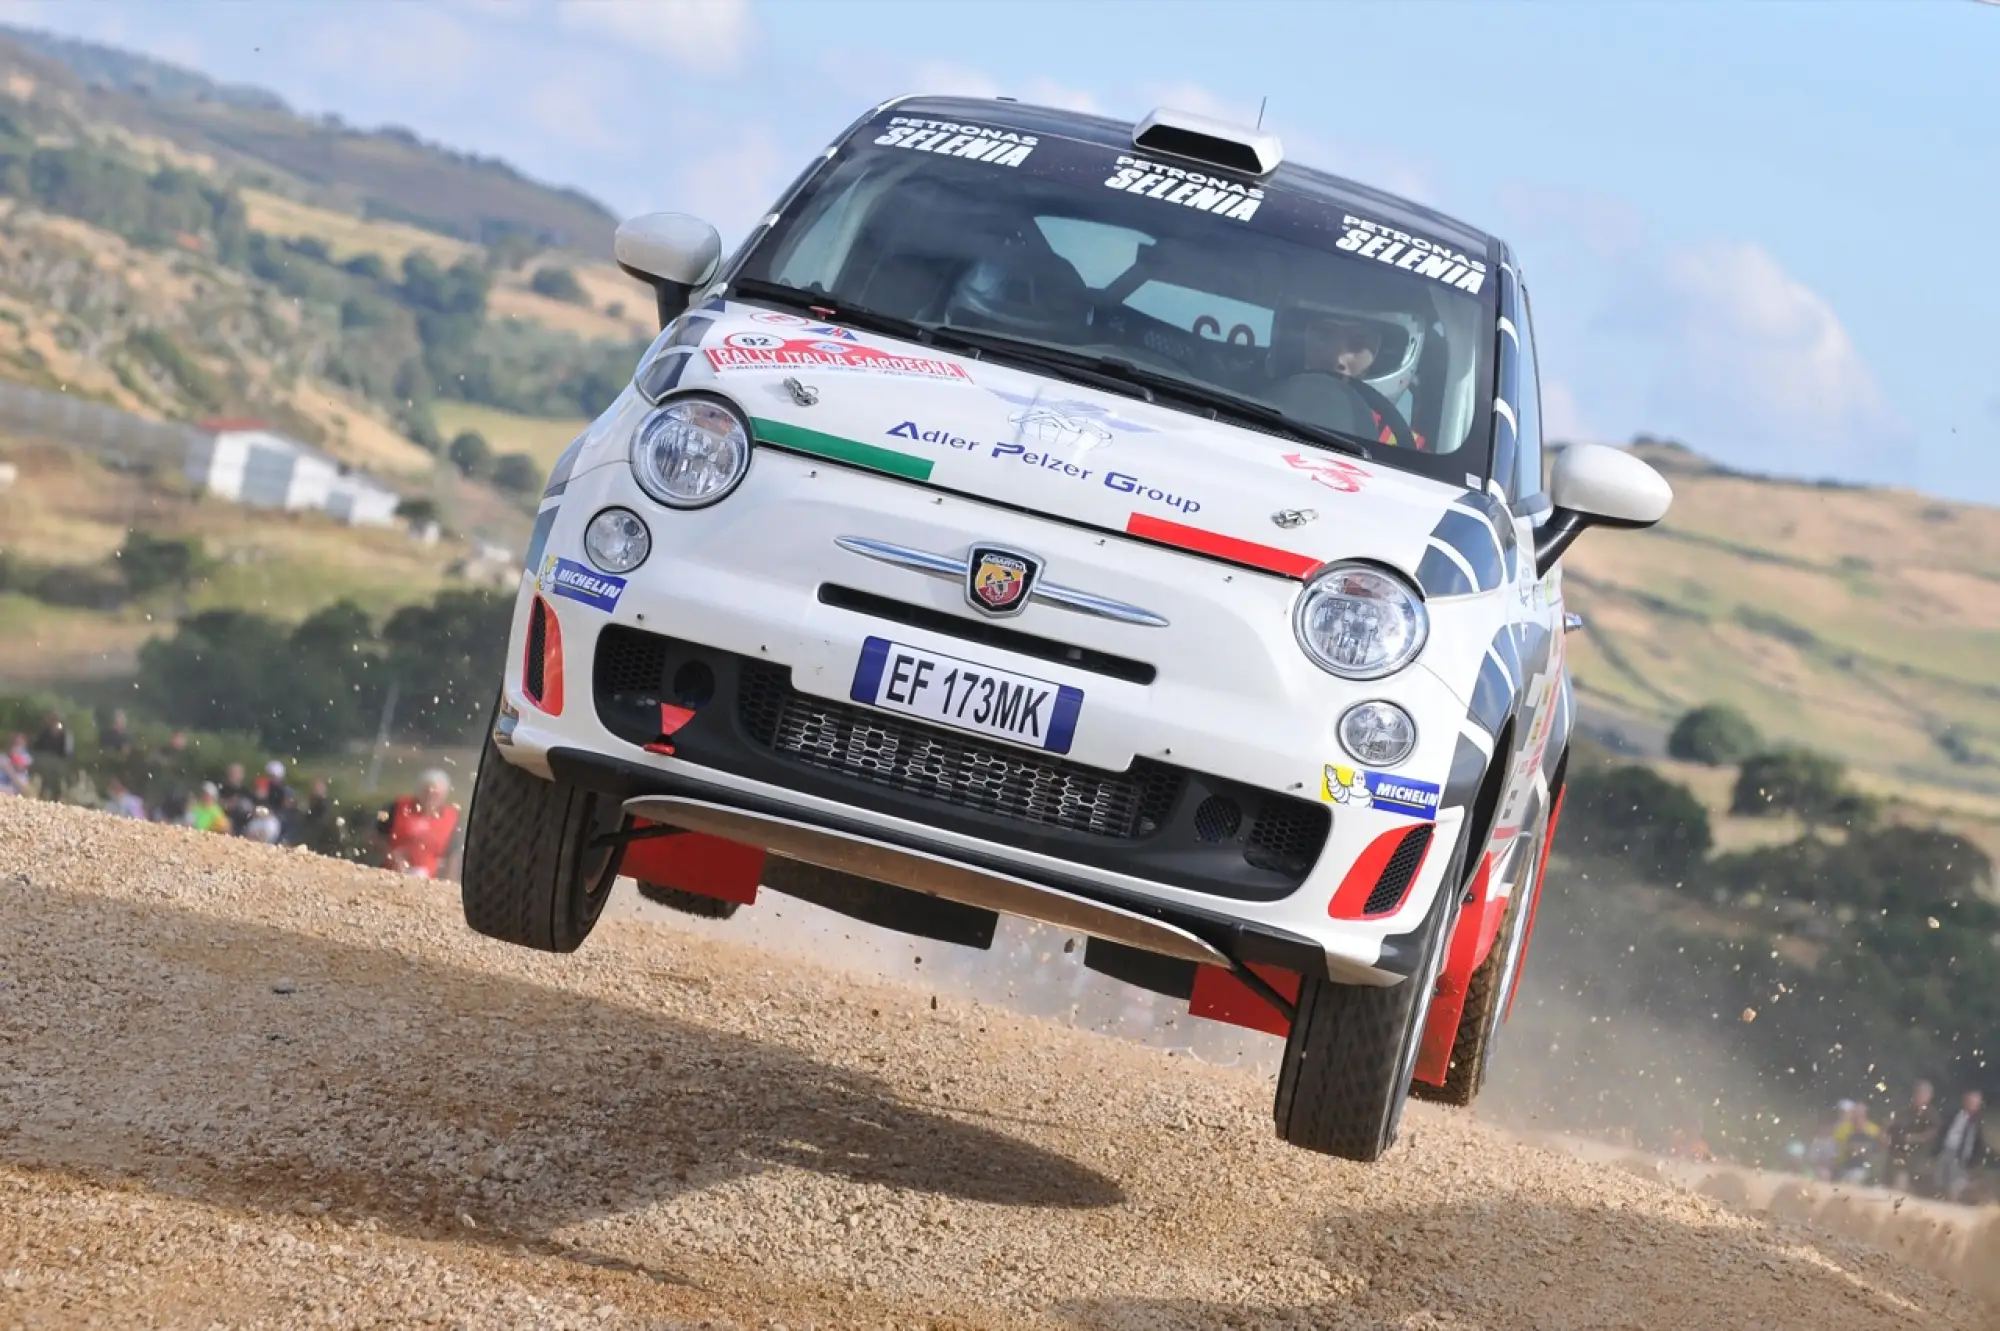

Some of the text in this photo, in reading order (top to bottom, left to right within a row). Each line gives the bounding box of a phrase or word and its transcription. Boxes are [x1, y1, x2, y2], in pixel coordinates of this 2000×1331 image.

[874, 127, 1034, 168] SELENIA
[889, 116, 1039, 146] PETRONAS
[1104, 168, 1262, 222] SELENIA
[1116, 155, 1265, 199] PETRONAS
[1335, 229, 1486, 295] SELENIA
[1343, 214, 1487, 273] PETRONAS
[716, 349, 778, 365] RALLY
[782, 351, 849, 366] ITALIA
[850, 355, 958, 378] SARDEGNA
[885, 421, 1201, 514] Adler Pelzer Group
[557, 568, 622, 599] MICHELIN
[886, 653, 1050, 738] EF 173MK
[1375, 782, 1439, 807] MICHELIN
